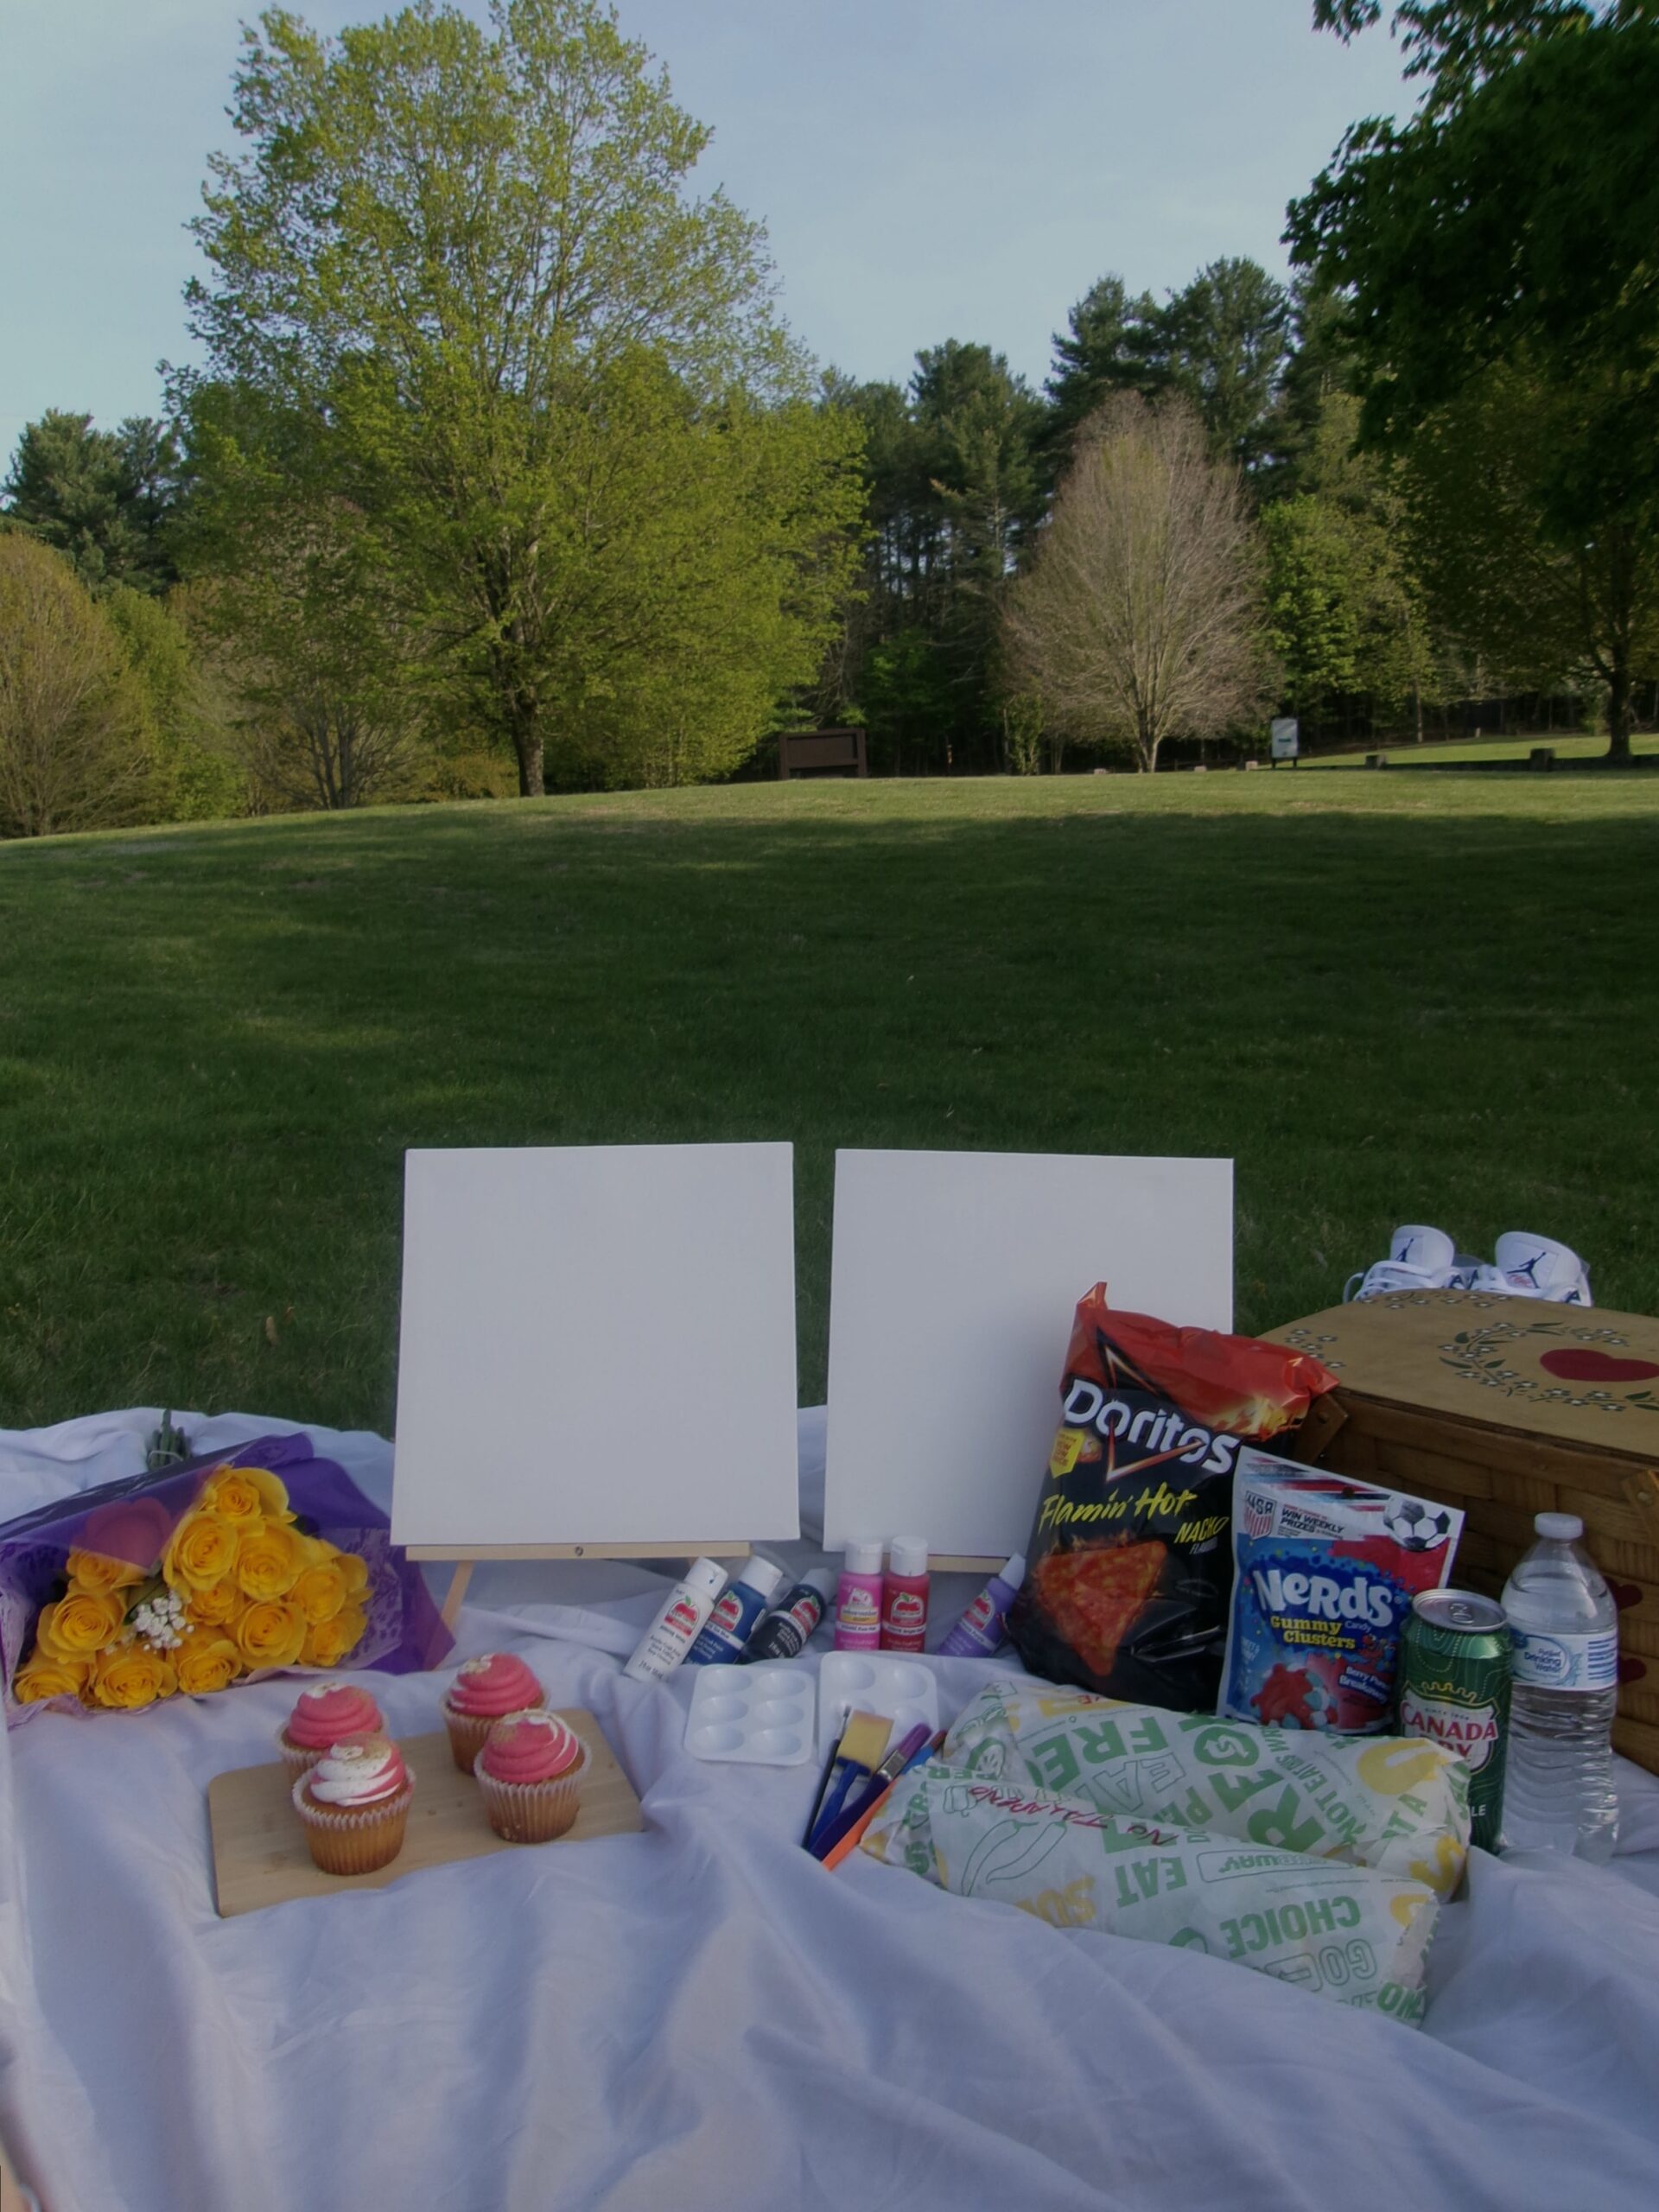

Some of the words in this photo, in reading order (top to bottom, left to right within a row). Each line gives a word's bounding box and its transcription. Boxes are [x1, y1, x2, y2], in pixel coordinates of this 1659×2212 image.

[1064, 1379, 1242, 1474] Doritos
[1134, 1481, 1198, 1518] Hot
[1248, 1495, 1274, 1514] USA
[1173, 1516, 1230, 1543] NACHO
[1281, 1508, 1300, 1520] WIN
[1305, 1514, 1344, 1534] WEEKLY
[1281, 1517, 1315, 1533] PRIZES
[1271, 1616, 1343, 1635] Gummy
[1344, 1621, 1372, 1633] Candy
[1283, 1630, 1356, 1649] Clusters
[1524, 1651, 1561, 1668] Drinking
[1401, 1701, 1497, 1740] CANADA
[1114, 1857, 1186, 1907] EAT
[1220, 1896, 1361, 1959] CHOICE
